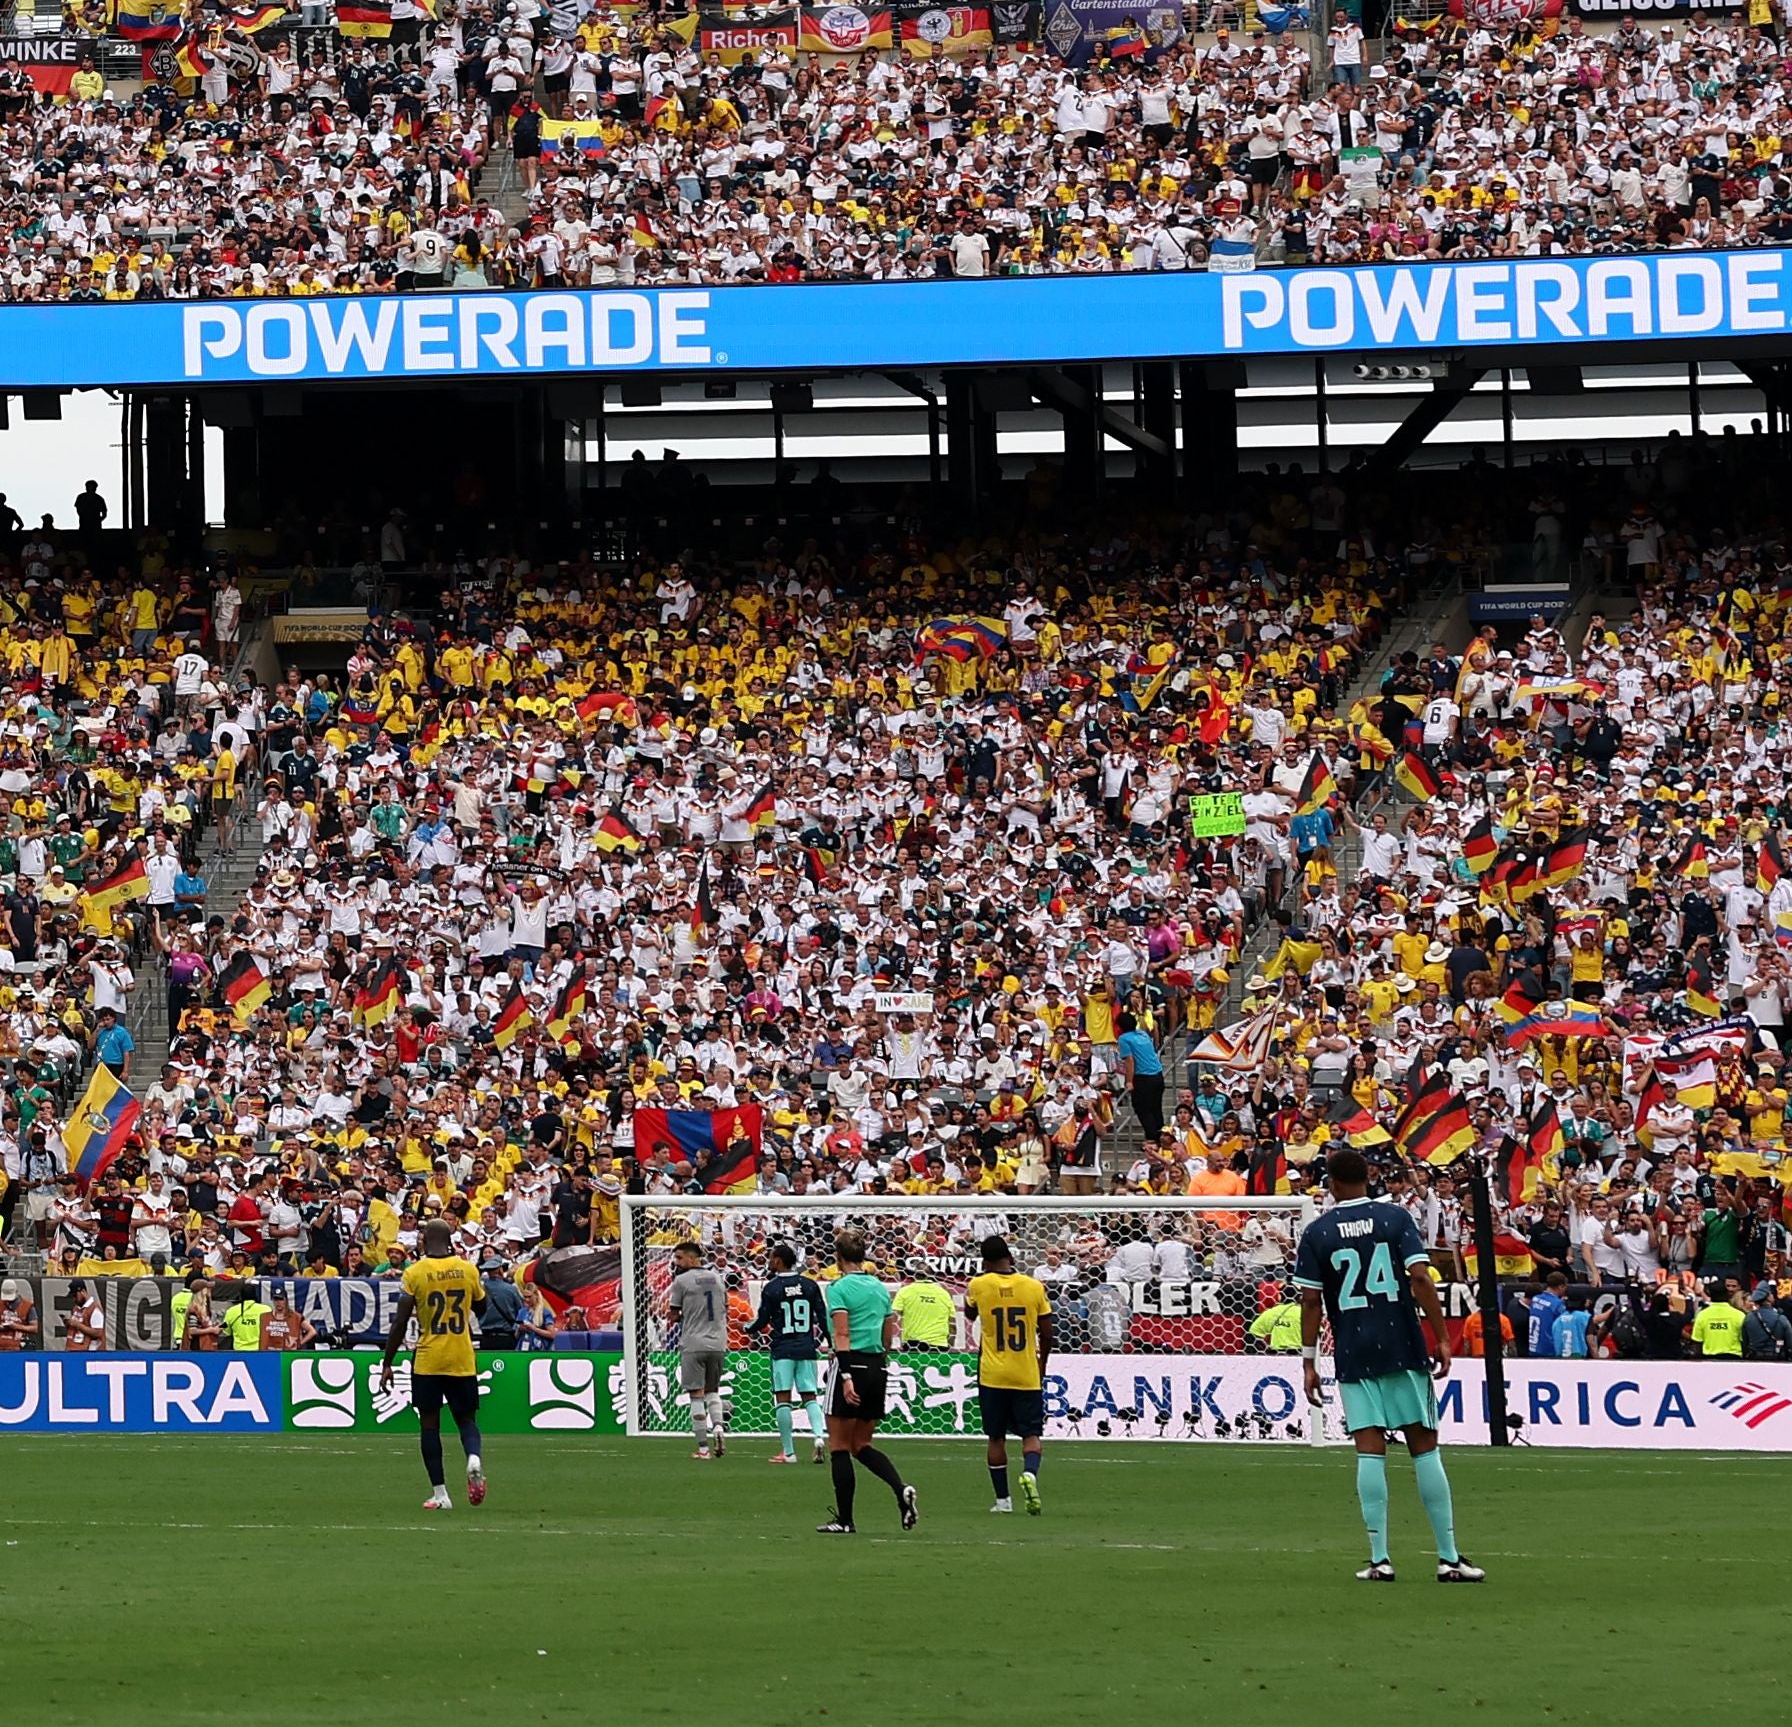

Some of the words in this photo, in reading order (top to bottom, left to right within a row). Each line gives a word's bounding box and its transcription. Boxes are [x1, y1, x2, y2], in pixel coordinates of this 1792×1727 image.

[114, 44, 136, 55] 223
[426, 239, 436, 256] 9
[1222, 253, 1784, 350] POWERADE
[184, 291, 712, 377] POWERADE
[1498, 602, 1525, 610] WORLD
[1527, 602, 1543, 610] CUP
[184, 660, 198, 676] 17
[1429, 706, 1442, 725] 6
[880, 997, 892, 1007] IN
[1330, 1241, 1400, 1311] 24
[427, 1290, 466, 1335] 23
[704, 1289, 714, 1322] 1
[781, 1299, 810, 1334] 19
[991, 1307, 1026, 1352] 15
[1042, 1374, 1223, 1424] BANK
